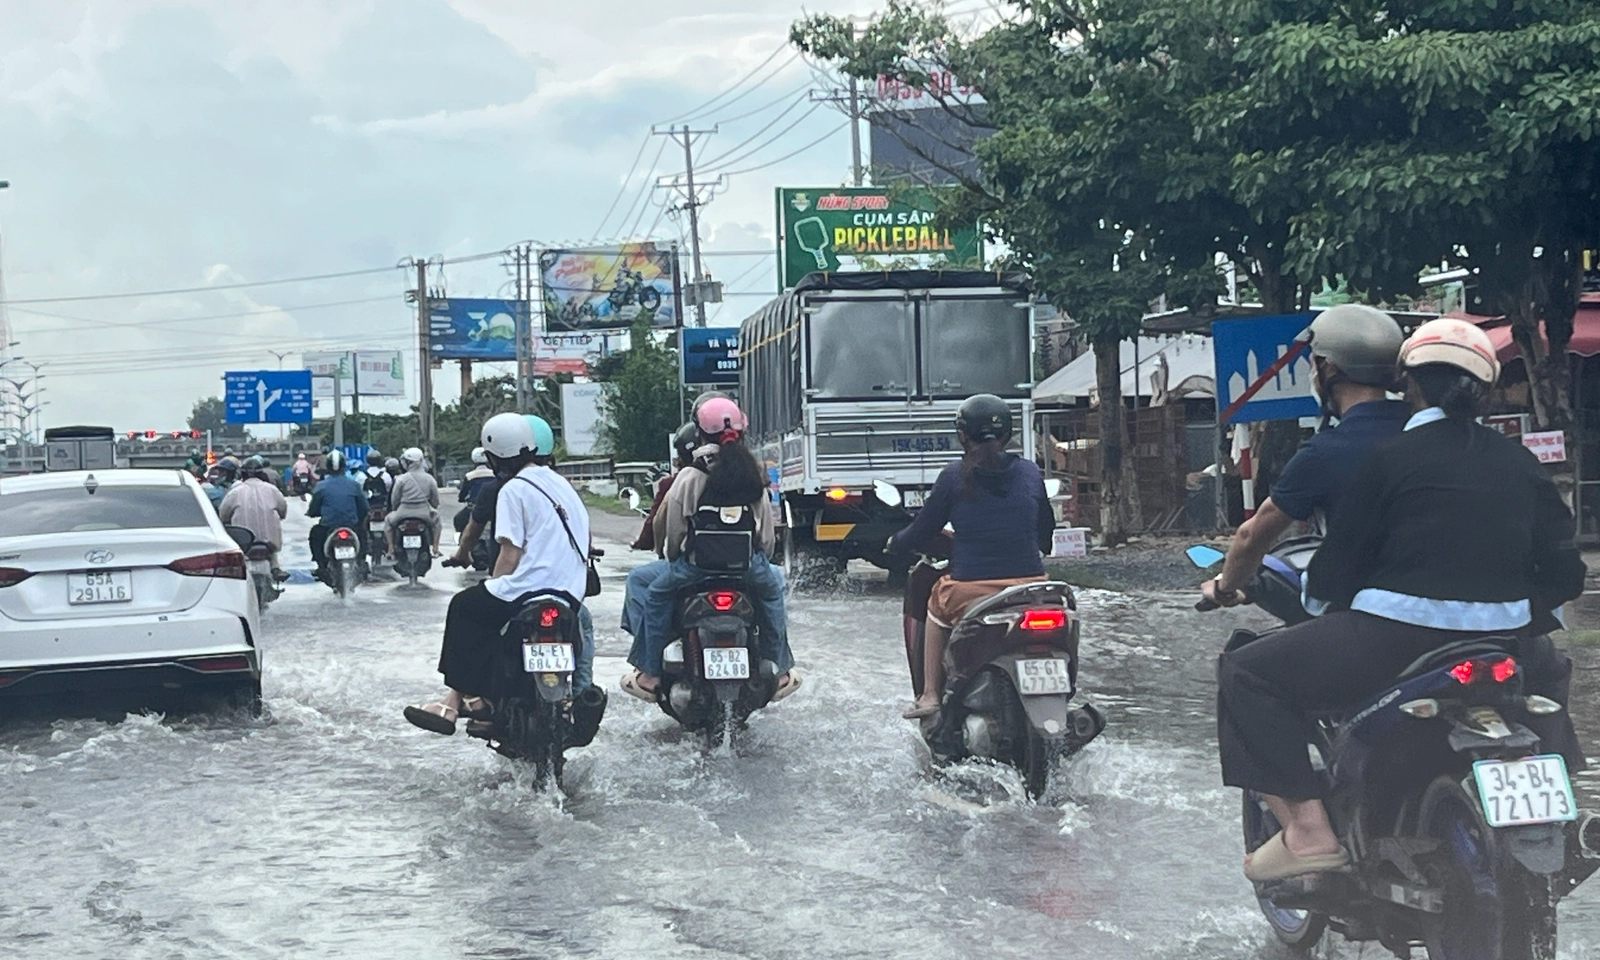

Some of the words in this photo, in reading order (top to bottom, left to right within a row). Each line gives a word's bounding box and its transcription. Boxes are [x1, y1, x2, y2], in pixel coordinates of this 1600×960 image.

[853, 213, 892, 227] CỤM
[897, 210, 935, 225] SÂN
[835, 227, 955, 252] PICKLEBALL
[86, 573, 113, 586] 65A
[76, 586, 126, 601] 291.16
[1489, 762, 1554, 792] 34-B4
[1488, 790, 1570, 822] 721.73
